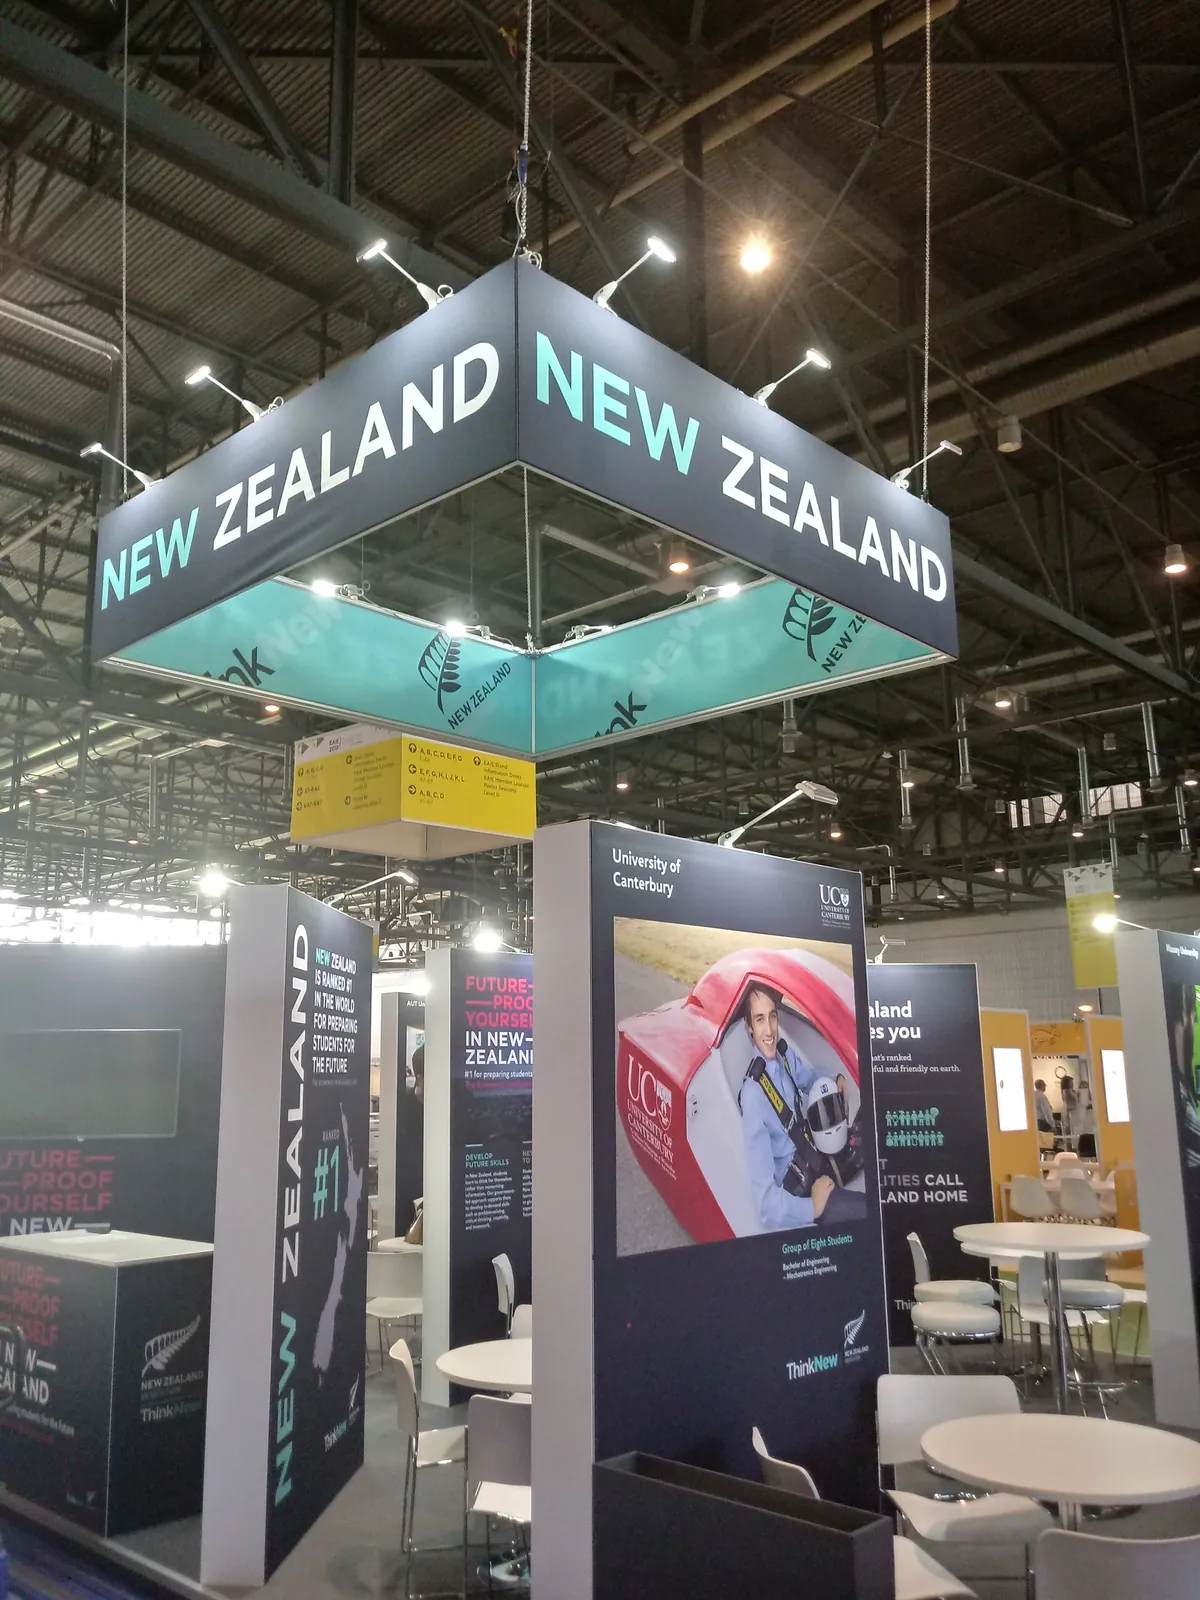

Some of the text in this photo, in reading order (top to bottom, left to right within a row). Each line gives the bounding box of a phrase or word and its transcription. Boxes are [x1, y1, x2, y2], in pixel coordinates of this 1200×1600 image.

[102, 342, 500, 611] NEW ZEALAND
[536, 331, 948, 602] NEW ZEALAND
[821, 631, 852, 673] NEW
[447, 662, 511, 730] NEW ZEALAND
[612, 847, 682, 875] University of
[612, 871, 674, 899] Canterbury
[819, 883, 841, 906] UC
[820, 911, 850, 921] CANTERBURY
[315, 947, 357, 975] NEW ZEALAND
[314, 969, 321, 985] IS
[322, 971, 346, 992] RANKED
[314, 990, 355, 1014] IN THE WORLD
[313, 1012, 358, 1034] FOR PREPARING
[313, 1034, 355, 1053] STUDENTS FOR
[465, 1031, 481, 1047] IN
[888, 1026, 921, 1044] you
[312, 1056, 348, 1073] THE FUTURE
[886, 1053, 912, 1062] ranked
[464, 1069, 533, 1080] #1 for preparing students
[885, 1064, 899, 1072] and
[900, 1064, 928, 1074] friendly
[940, 1064, 961, 1072] earth.
[627, 1053, 657, 1117] UC
[282, 924, 309, 1284] ZEALAND
[627, 1098, 673, 1149] UNIVERSITY OF
[322, 1129, 339, 1141] RANKED
[627, 1113, 674, 1164] CANTERBURY
[465, 1152, 493, 1161] DEVELOP
[465, 1158, 509, 1168] FUTURE SKILLS
[313, 1145, 339, 1221] #1
[924, 1173, 964, 1186] CALL
[924, 1190, 968, 1202] HOME
[782, 1234, 853, 1255] Group of Eight Students
[782, 1256, 830, 1271] Bachelor of Engineering
[786, 1269, 814, 1280] Mechatronics
[814, 1264, 837, 1275] Engineering
[844, 1345, 869, 1358] NEW ZEALAND
[786, 1353, 838, 1380] ThinkNew
[141, 1370, 204, 1391] NEW ZEALAND
[275, 1311, 297, 1507] NEW
